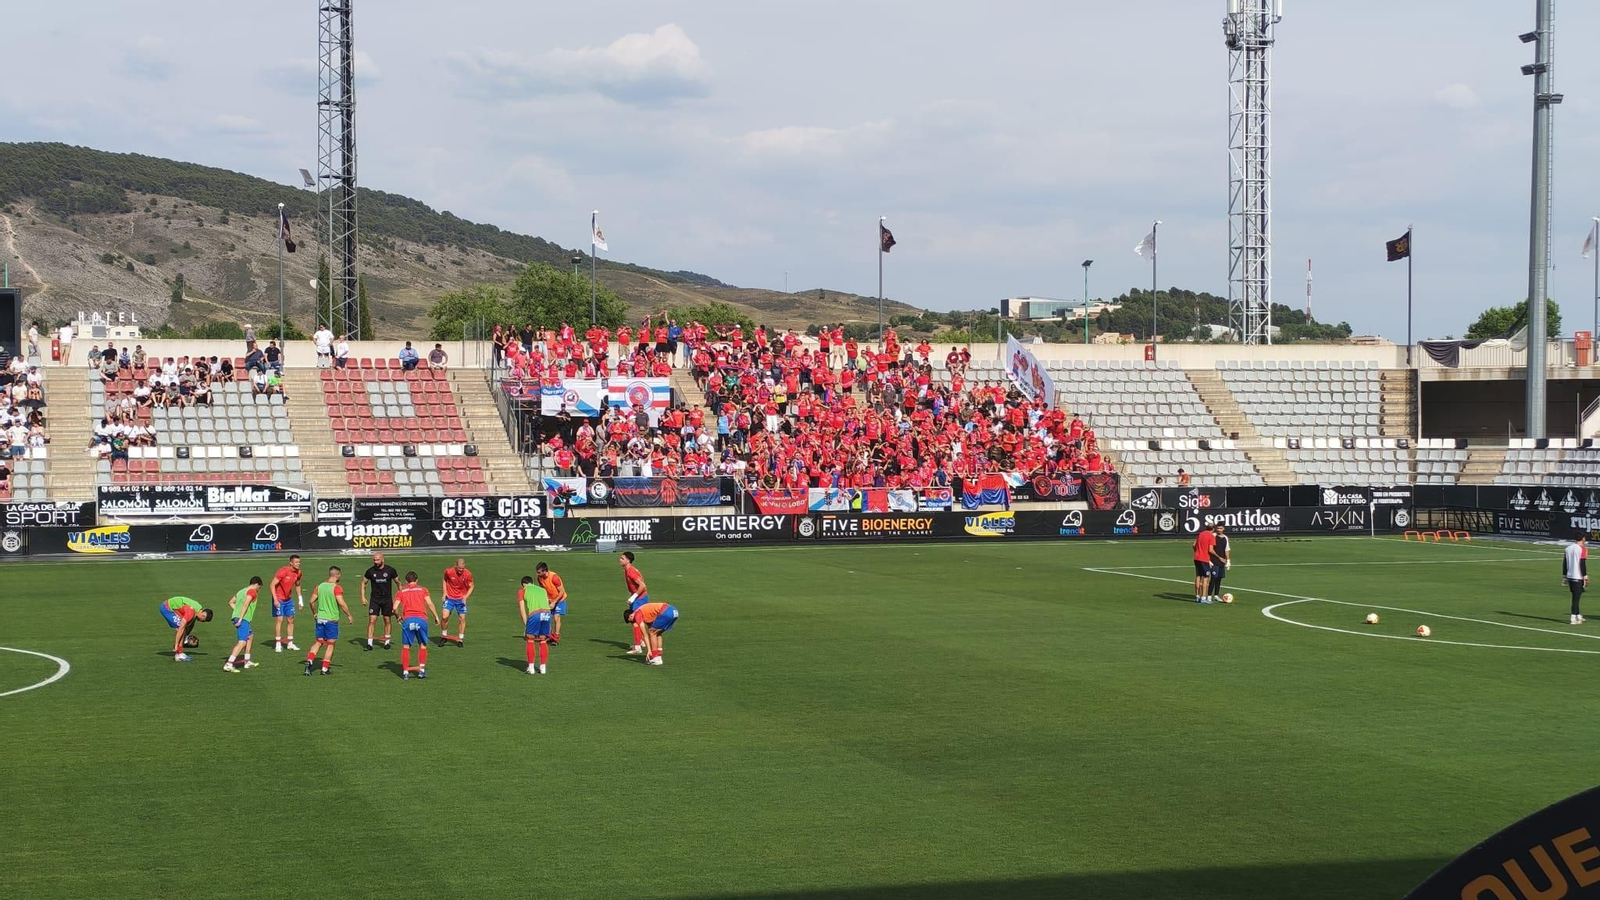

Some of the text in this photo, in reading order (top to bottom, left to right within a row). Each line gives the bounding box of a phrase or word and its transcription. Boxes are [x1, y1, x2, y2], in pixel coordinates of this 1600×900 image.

[78, 311, 138, 322] HOTEL
[208, 486, 270, 507] BigMat
[6, 511, 80, 524] SPORT
[682, 515, 785, 531] GRENERGY
[823, 518, 932, 530] FIVE BIOENERGY
[965, 516, 1015, 528] VIALES
[1184, 509, 1280, 532] 5 sentidos
[1311, 506, 1364, 530] ARKIN
[1499, 517, 1550, 530] FIVE WORKS
[1570, 514, 1600, 532] ruja
[318, 520, 412, 540] rujamar
[442, 520, 541, 529] CERVEZAS
[598, 520, 652, 534] TOROVERDE
[68, 532, 130, 544] VIALES
[432, 528, 550, 540] VICTORIA
[252, 542, 282, 550] trendit
[353, 536, 412, 547] SPORTSTEAM
